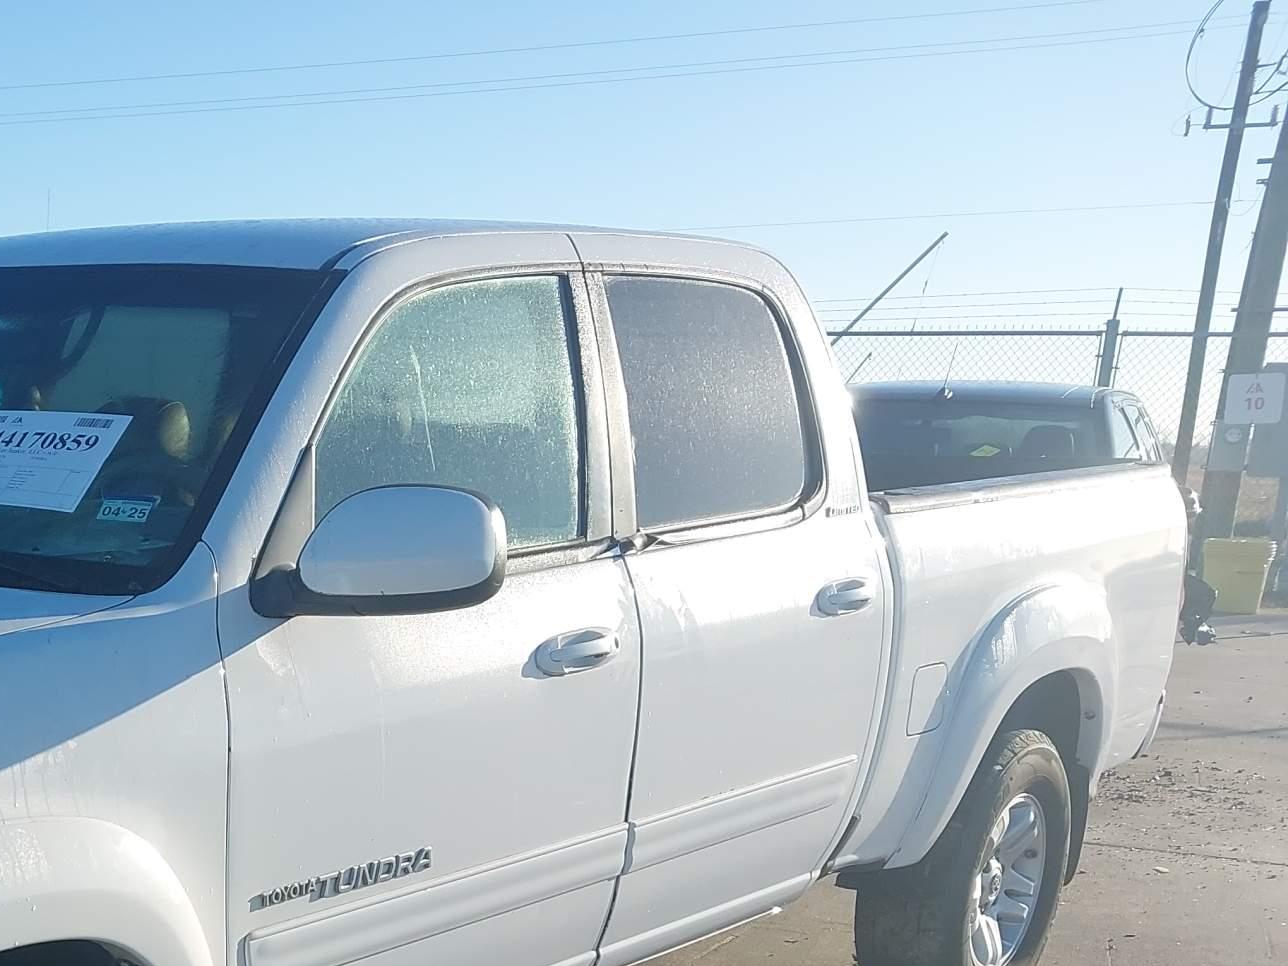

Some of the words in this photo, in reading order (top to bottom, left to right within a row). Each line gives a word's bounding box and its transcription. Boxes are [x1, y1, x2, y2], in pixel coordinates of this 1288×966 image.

[1244, 397, 1265, 410] 10
[102, 506, 121, 517] 04
[128, 507, 148, 519] 25
[263, 877, 317, 907] TOYOTA
[310, 846, 433, 902] TUNDRA
